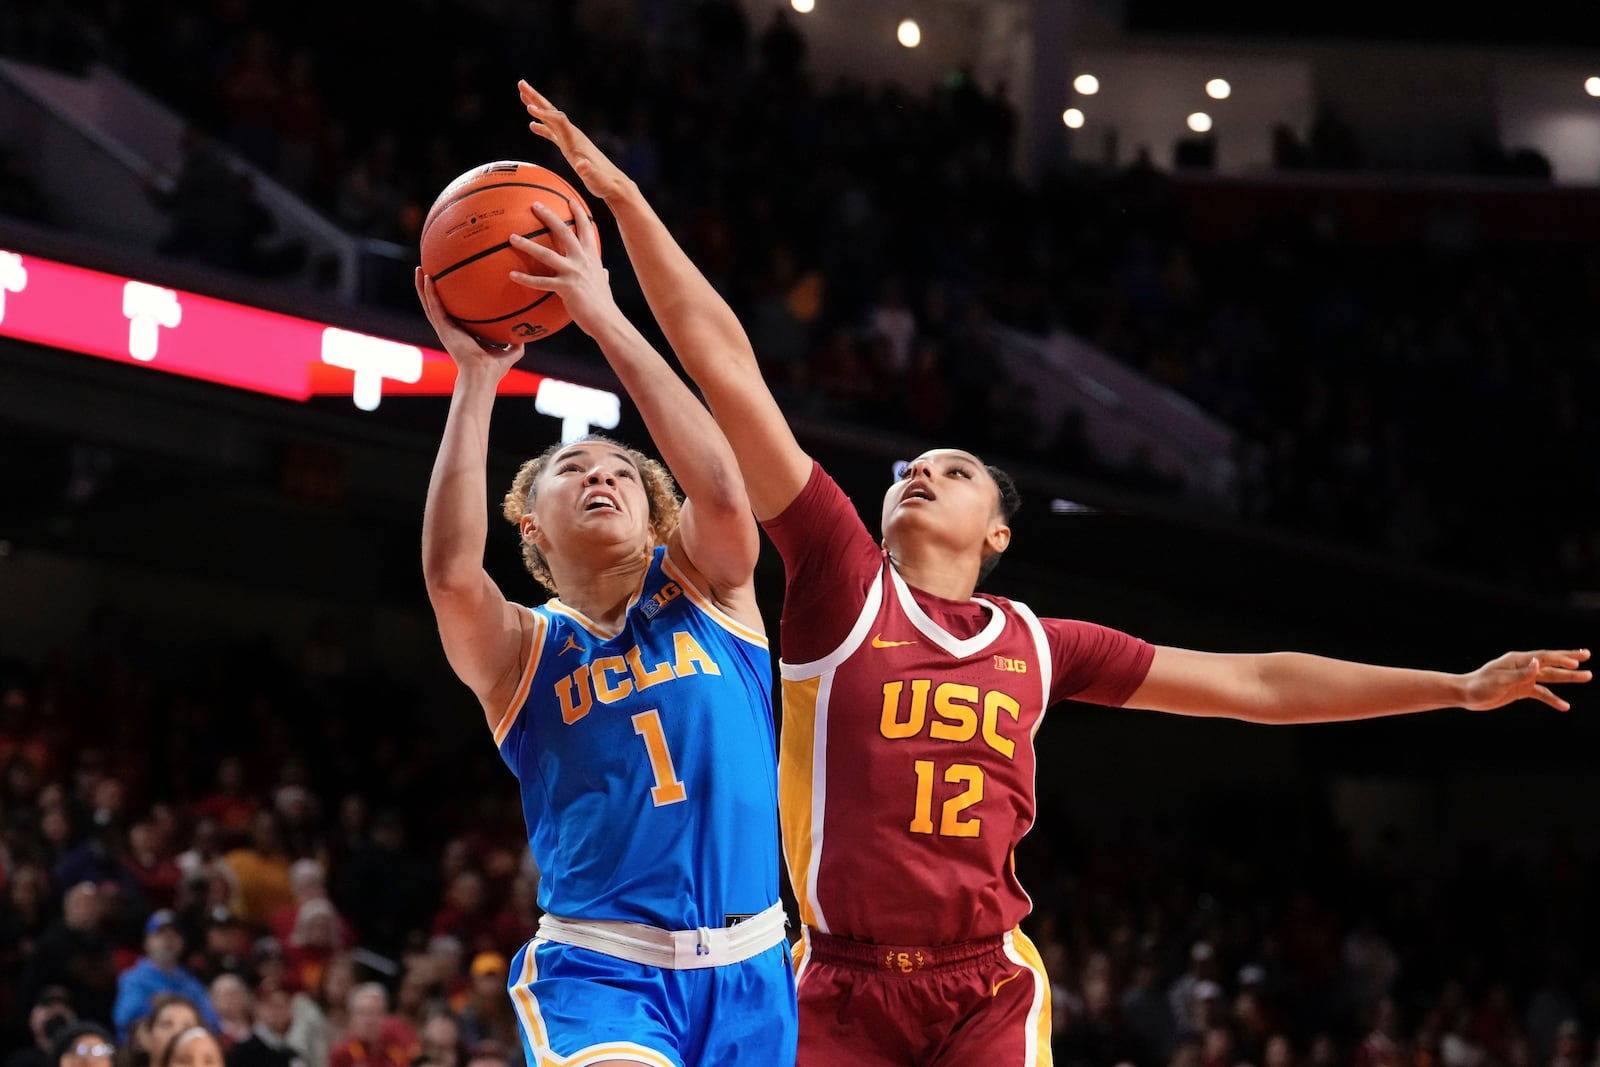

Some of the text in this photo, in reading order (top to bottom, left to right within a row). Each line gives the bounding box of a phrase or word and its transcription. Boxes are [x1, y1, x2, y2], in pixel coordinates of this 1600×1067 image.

[554, 631, 721, 726] UCLA
[878, 679, 1021, 760] USC
[631, 708, 688, 808] 1
[909, 759, 985, 838] 12
